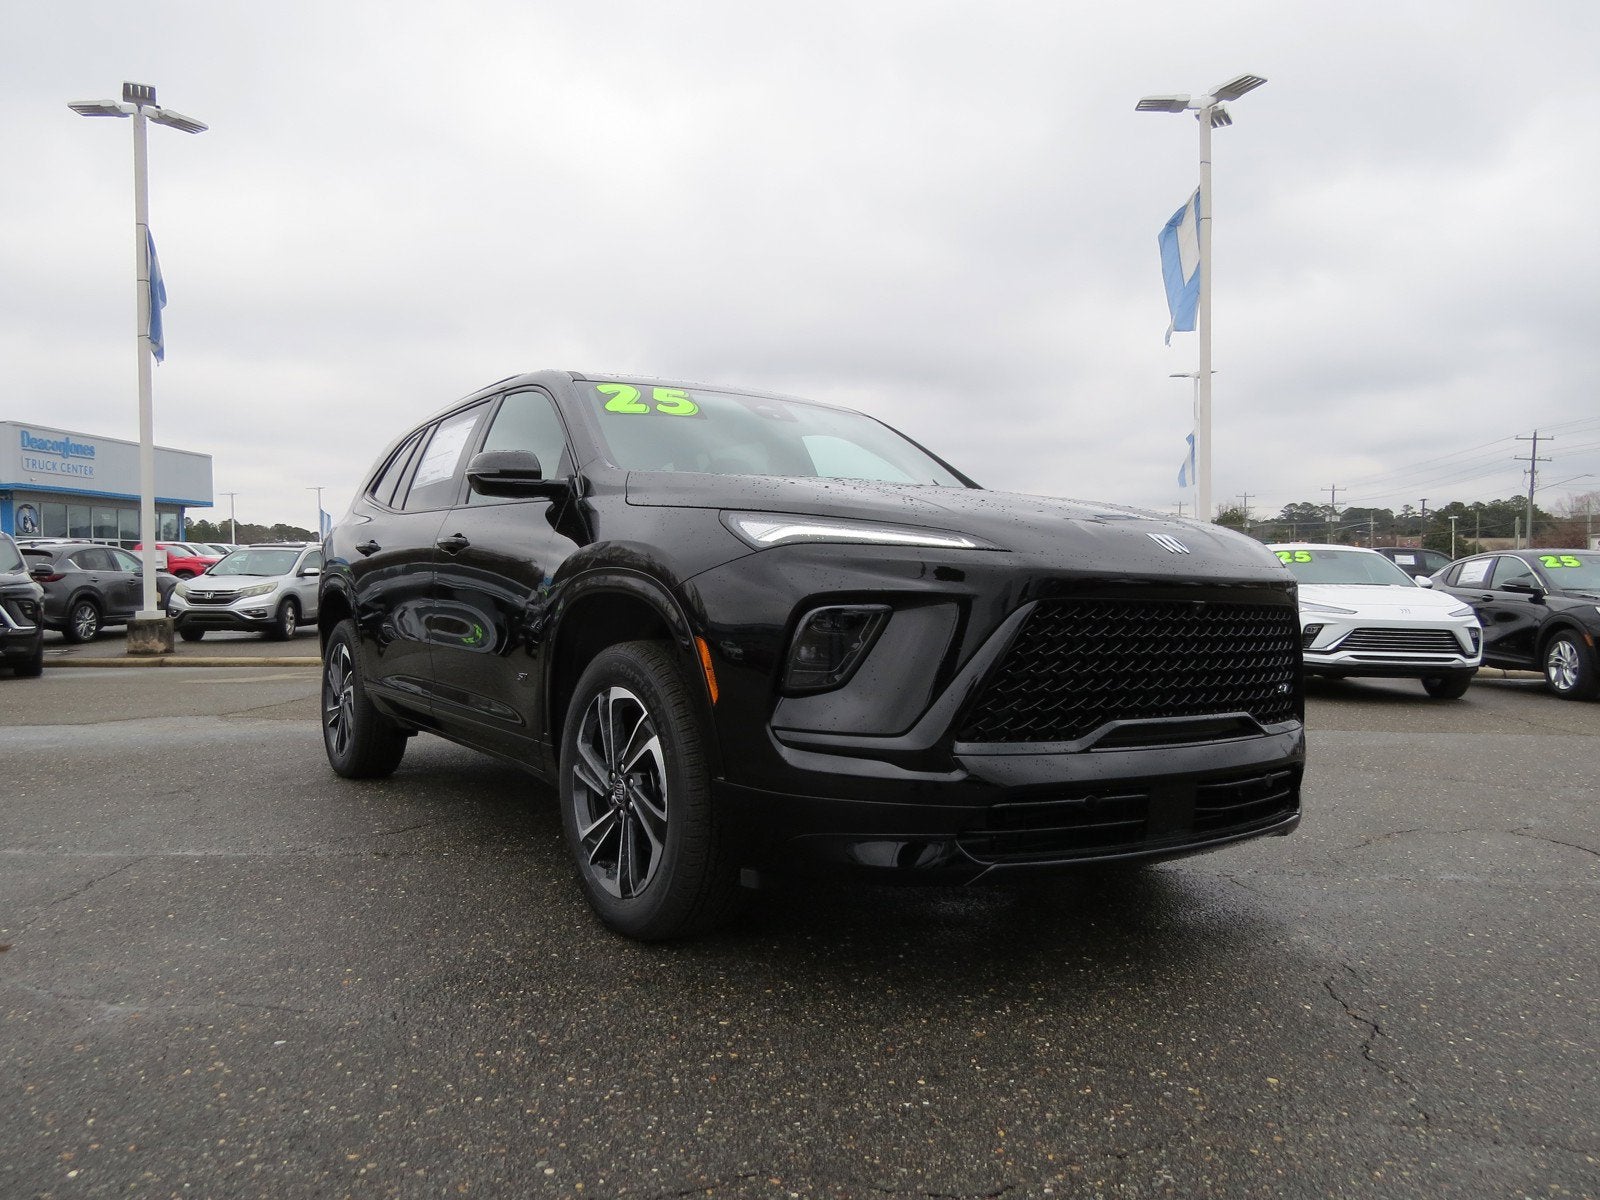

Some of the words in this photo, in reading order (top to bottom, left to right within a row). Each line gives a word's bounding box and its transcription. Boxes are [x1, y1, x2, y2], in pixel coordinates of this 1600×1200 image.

[595, 383, 700, 417] 25
[25, 457, 57, 471] TRUCK
[60, 462, 94, 476] CENTER
[1273, 549, 1312, 563] 25
[1538, 554, 1581, 568] 25
